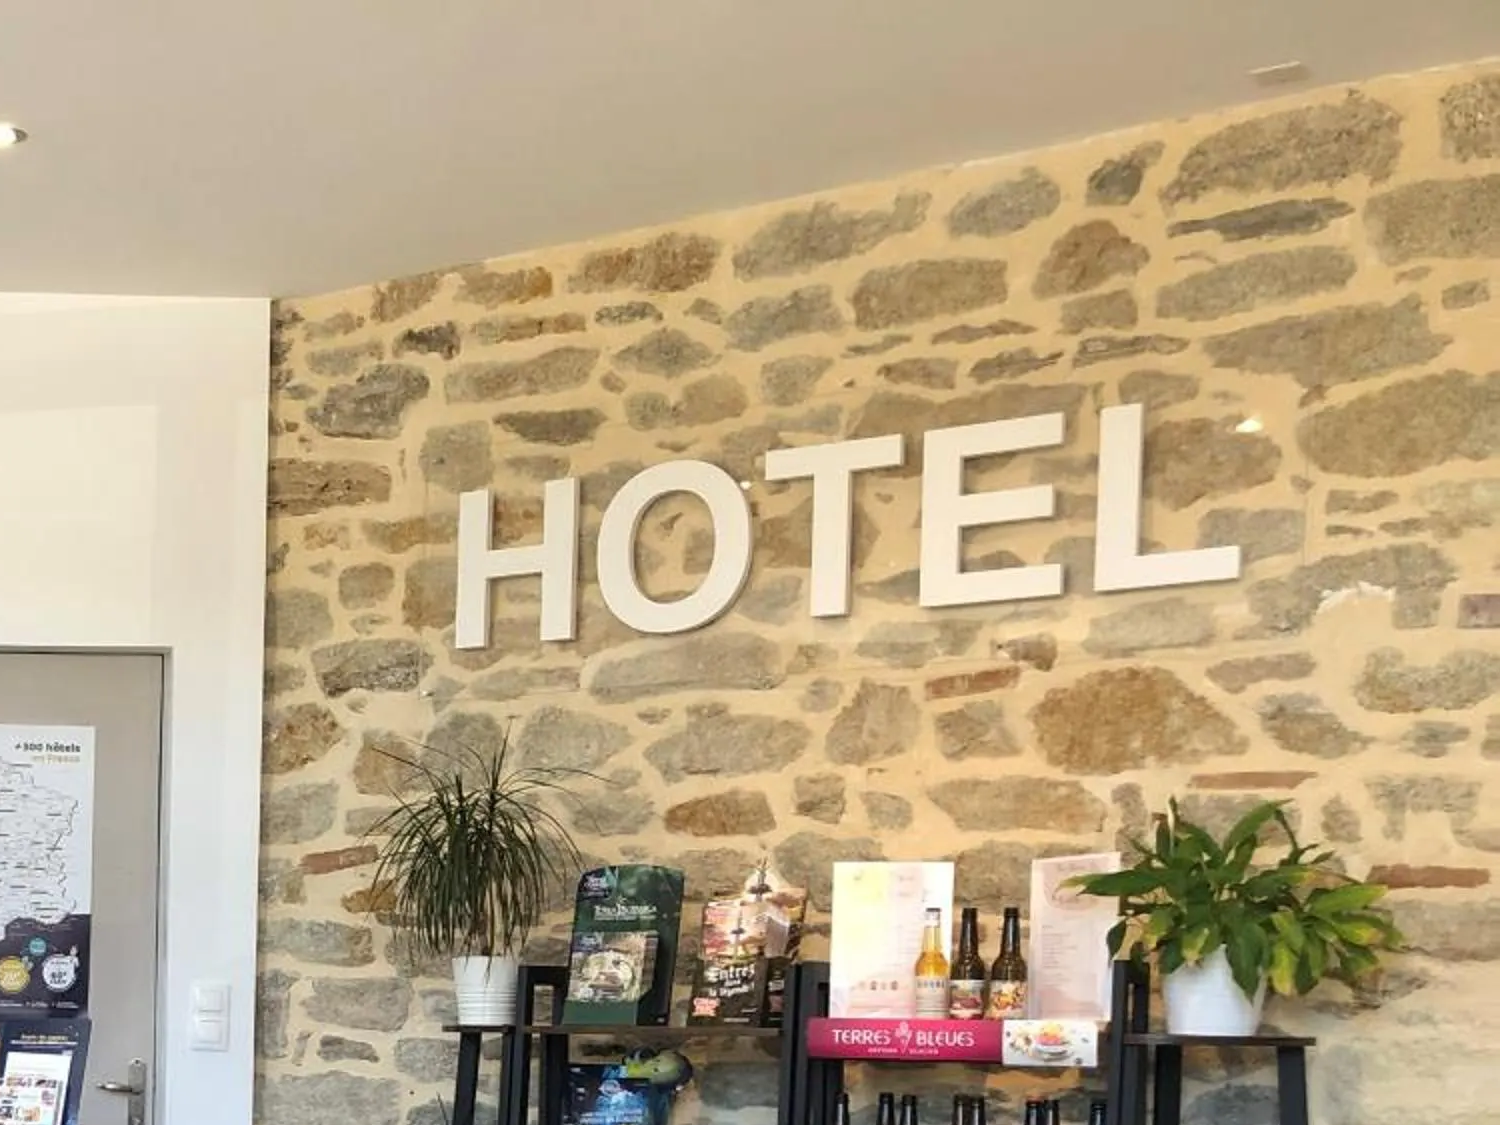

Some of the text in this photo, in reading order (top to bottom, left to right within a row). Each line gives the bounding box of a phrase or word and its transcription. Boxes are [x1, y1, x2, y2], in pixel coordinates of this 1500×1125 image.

[454, 402, 1243, 650] HOTEL
[45, 741, 81, 753] hôtels
[831, 1028, 976, 1047] TERRES BLEUES
